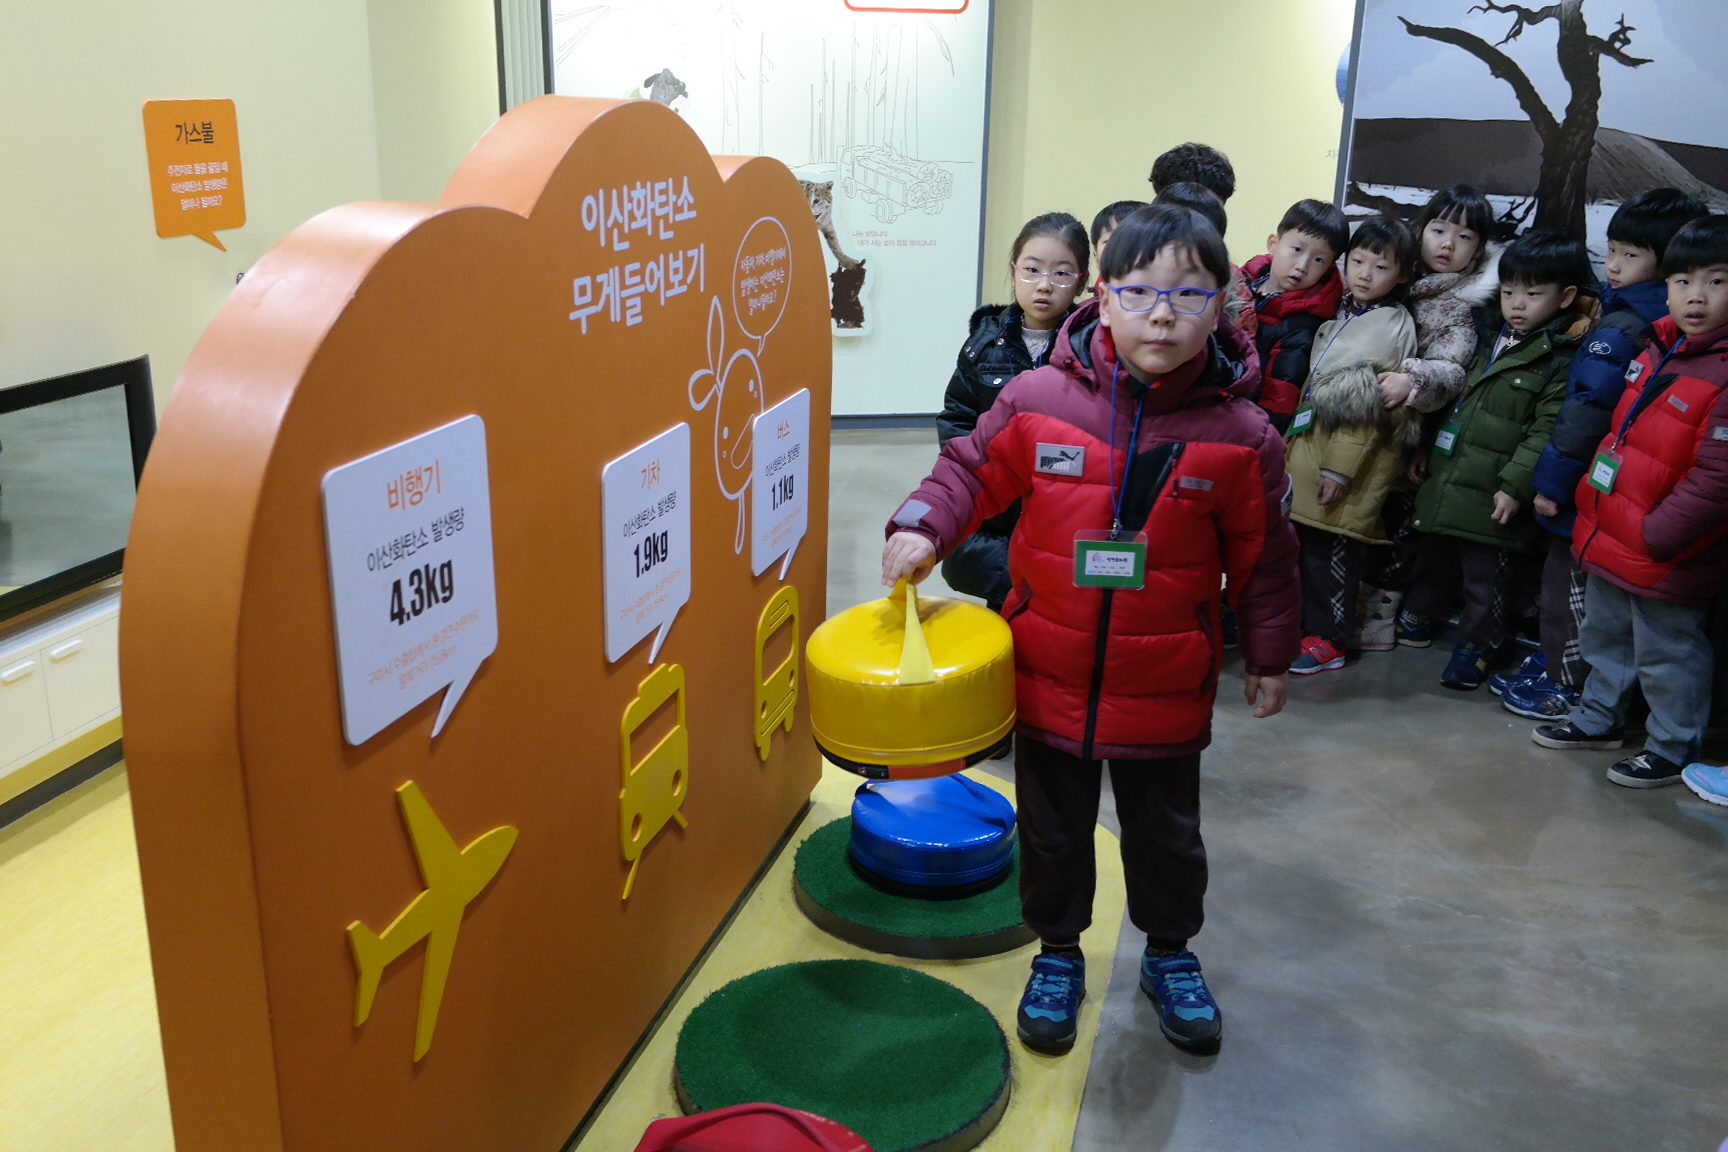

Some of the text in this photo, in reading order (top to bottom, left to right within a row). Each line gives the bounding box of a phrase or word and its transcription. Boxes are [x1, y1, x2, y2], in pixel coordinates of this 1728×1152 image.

[175, 121, 214, 145] 가스불
[171, 177, 228, 194] 이산화탄소 발생량은
[180, 197, 200, 211] 얼마나
[581, 175, 697, 251] 이산화탄소
[569, 243, 705, 335] 무게들어보기
[760, 267, 785, 289] 이산화탄소는
[777, 418, 790, 441] 버스
[641, 458, 661, 490] 기차
[765, 443, 801, 477] 이산화탄소 발생량
[386, 459, 441, 510] 비행기
[772, 474, 794, 511] 1.1kg
[623, 490, 677, 538] 이산화탄소 발생량
[367, 506, 465, 571] 이산화탄소 발생량
[634, 530, 669, 578] 1.9kg
[390, 559, 454, 626] 4.3kg
